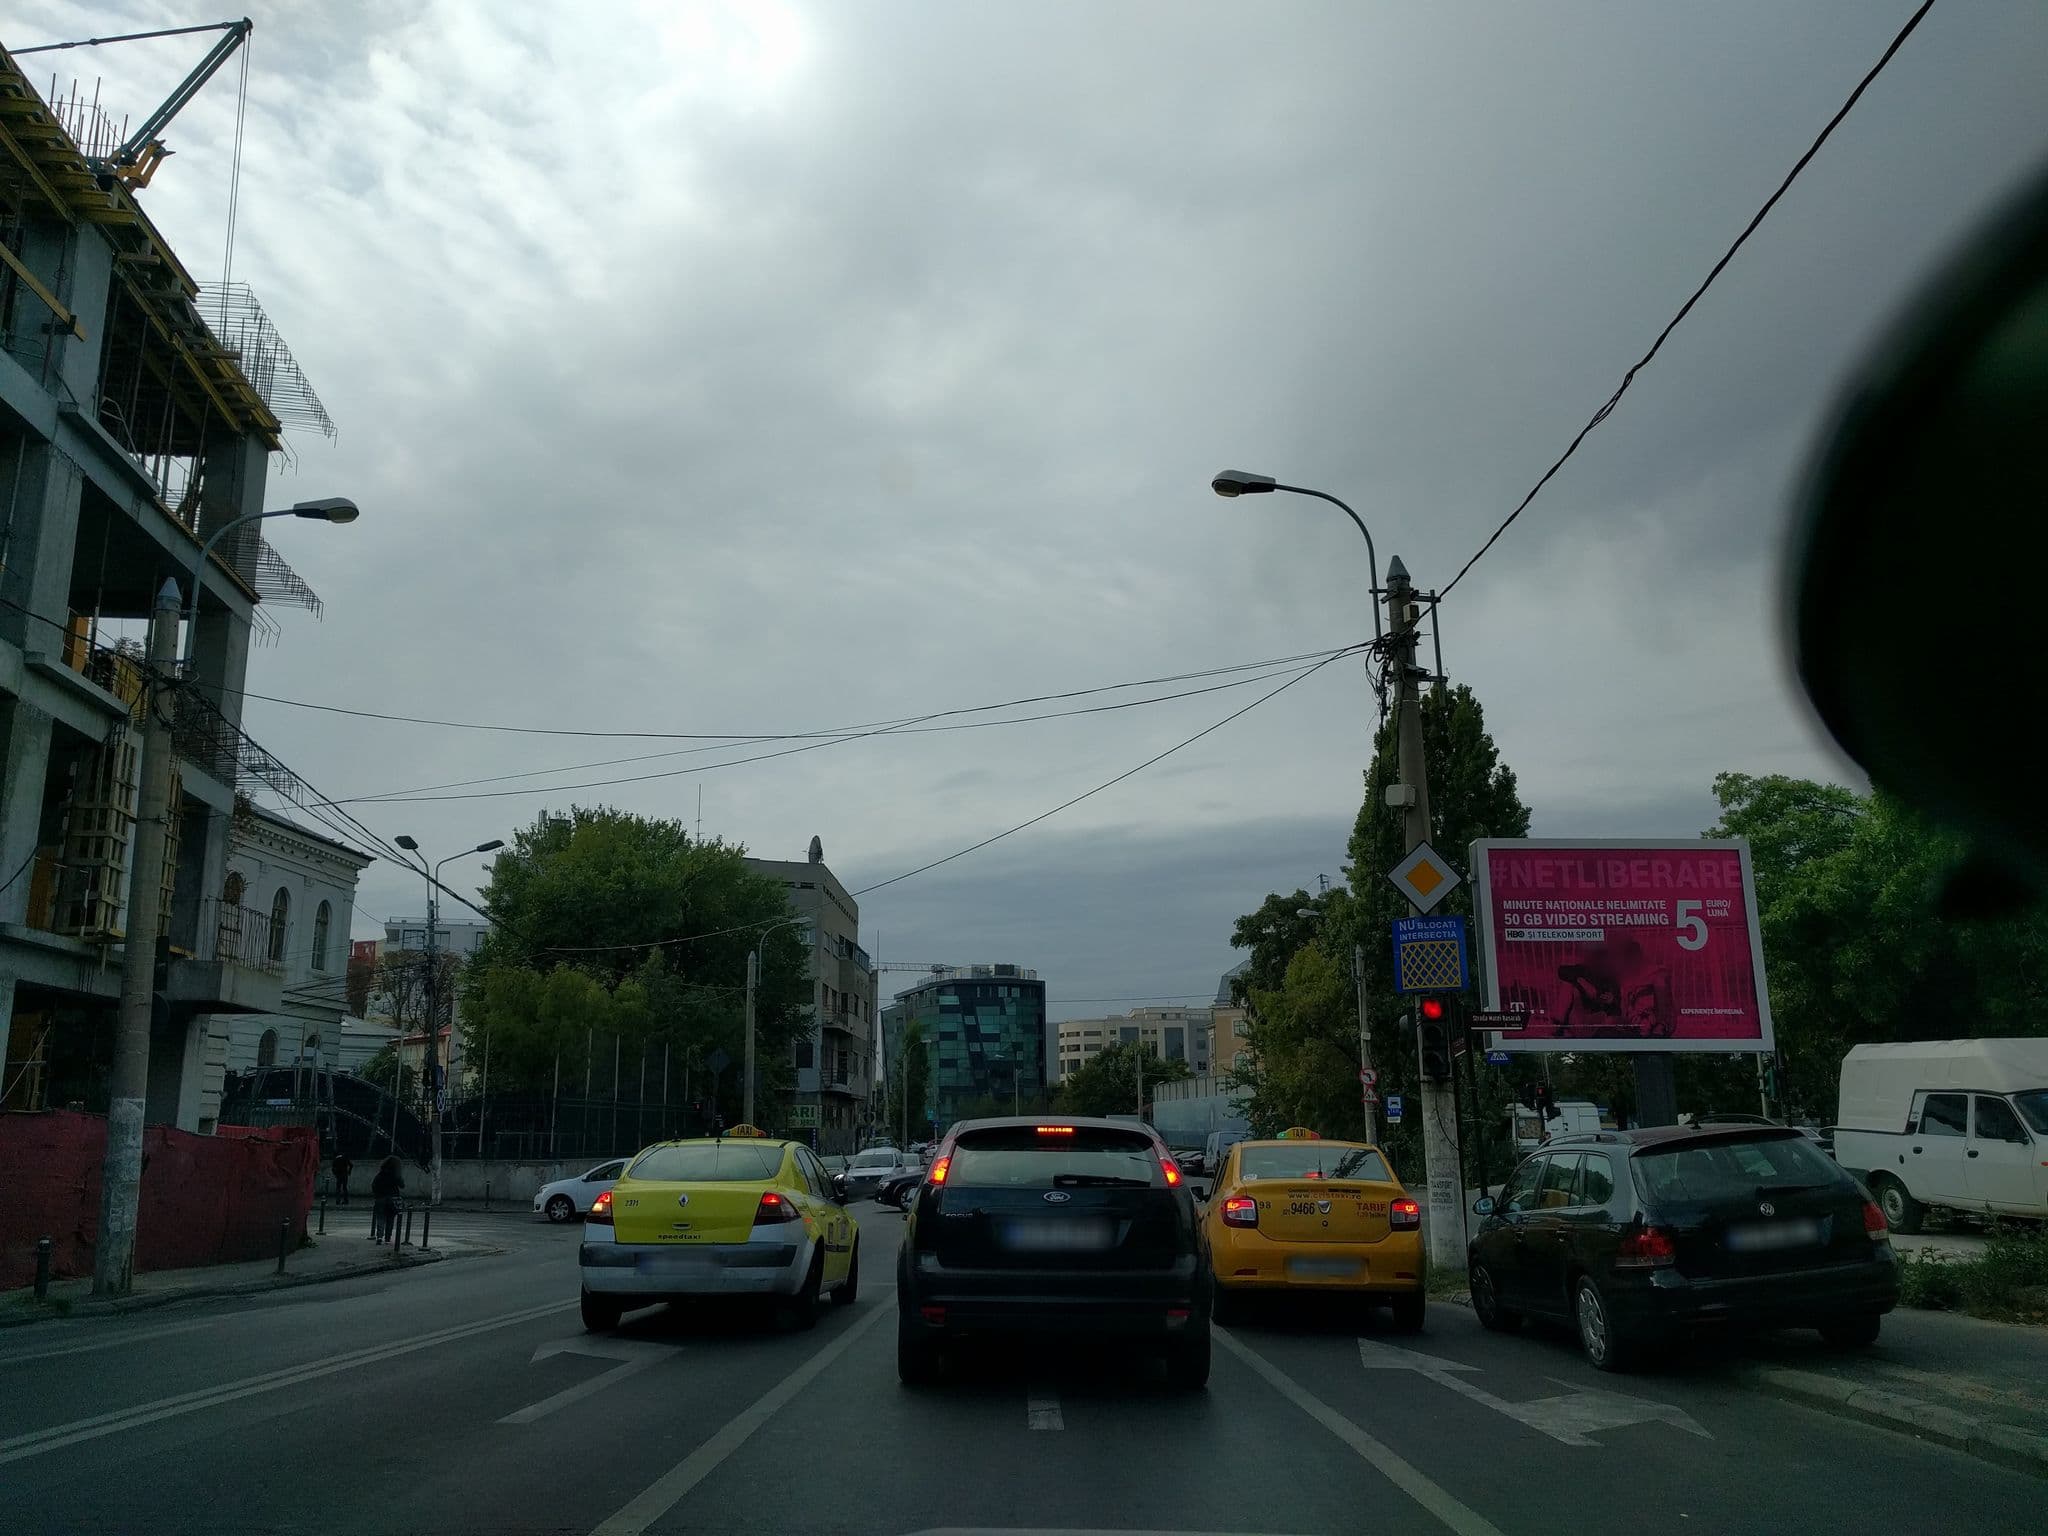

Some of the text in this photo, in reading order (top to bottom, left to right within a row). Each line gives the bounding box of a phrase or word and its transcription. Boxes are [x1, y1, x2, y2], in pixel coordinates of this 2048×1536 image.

[1490, 859, 1742, 889] #NETLIBERARE
[1503, 900, 1543, 910] MINUTE
[1606, 900, 1666, 910] NELIMITATE
[1706, 899, 1731, 909] EURO/
[1504, 913, 1669, 926] 50 GB VIDEO STREAMING
[1399, 920, 1415, 931] NU
[1675, 899, 1709, 951] 5
[1506, 930, 1525, 938] HBO
[1576, 931, 1602, 939] SPORT
[737, 1126, 753, 1136] TAXI
[1293, 1129, 1306, 1138] TAXI
[1290, 1202, 1315, 1215] 9466
[1356, 1202, 1386, 1211] TARIF
